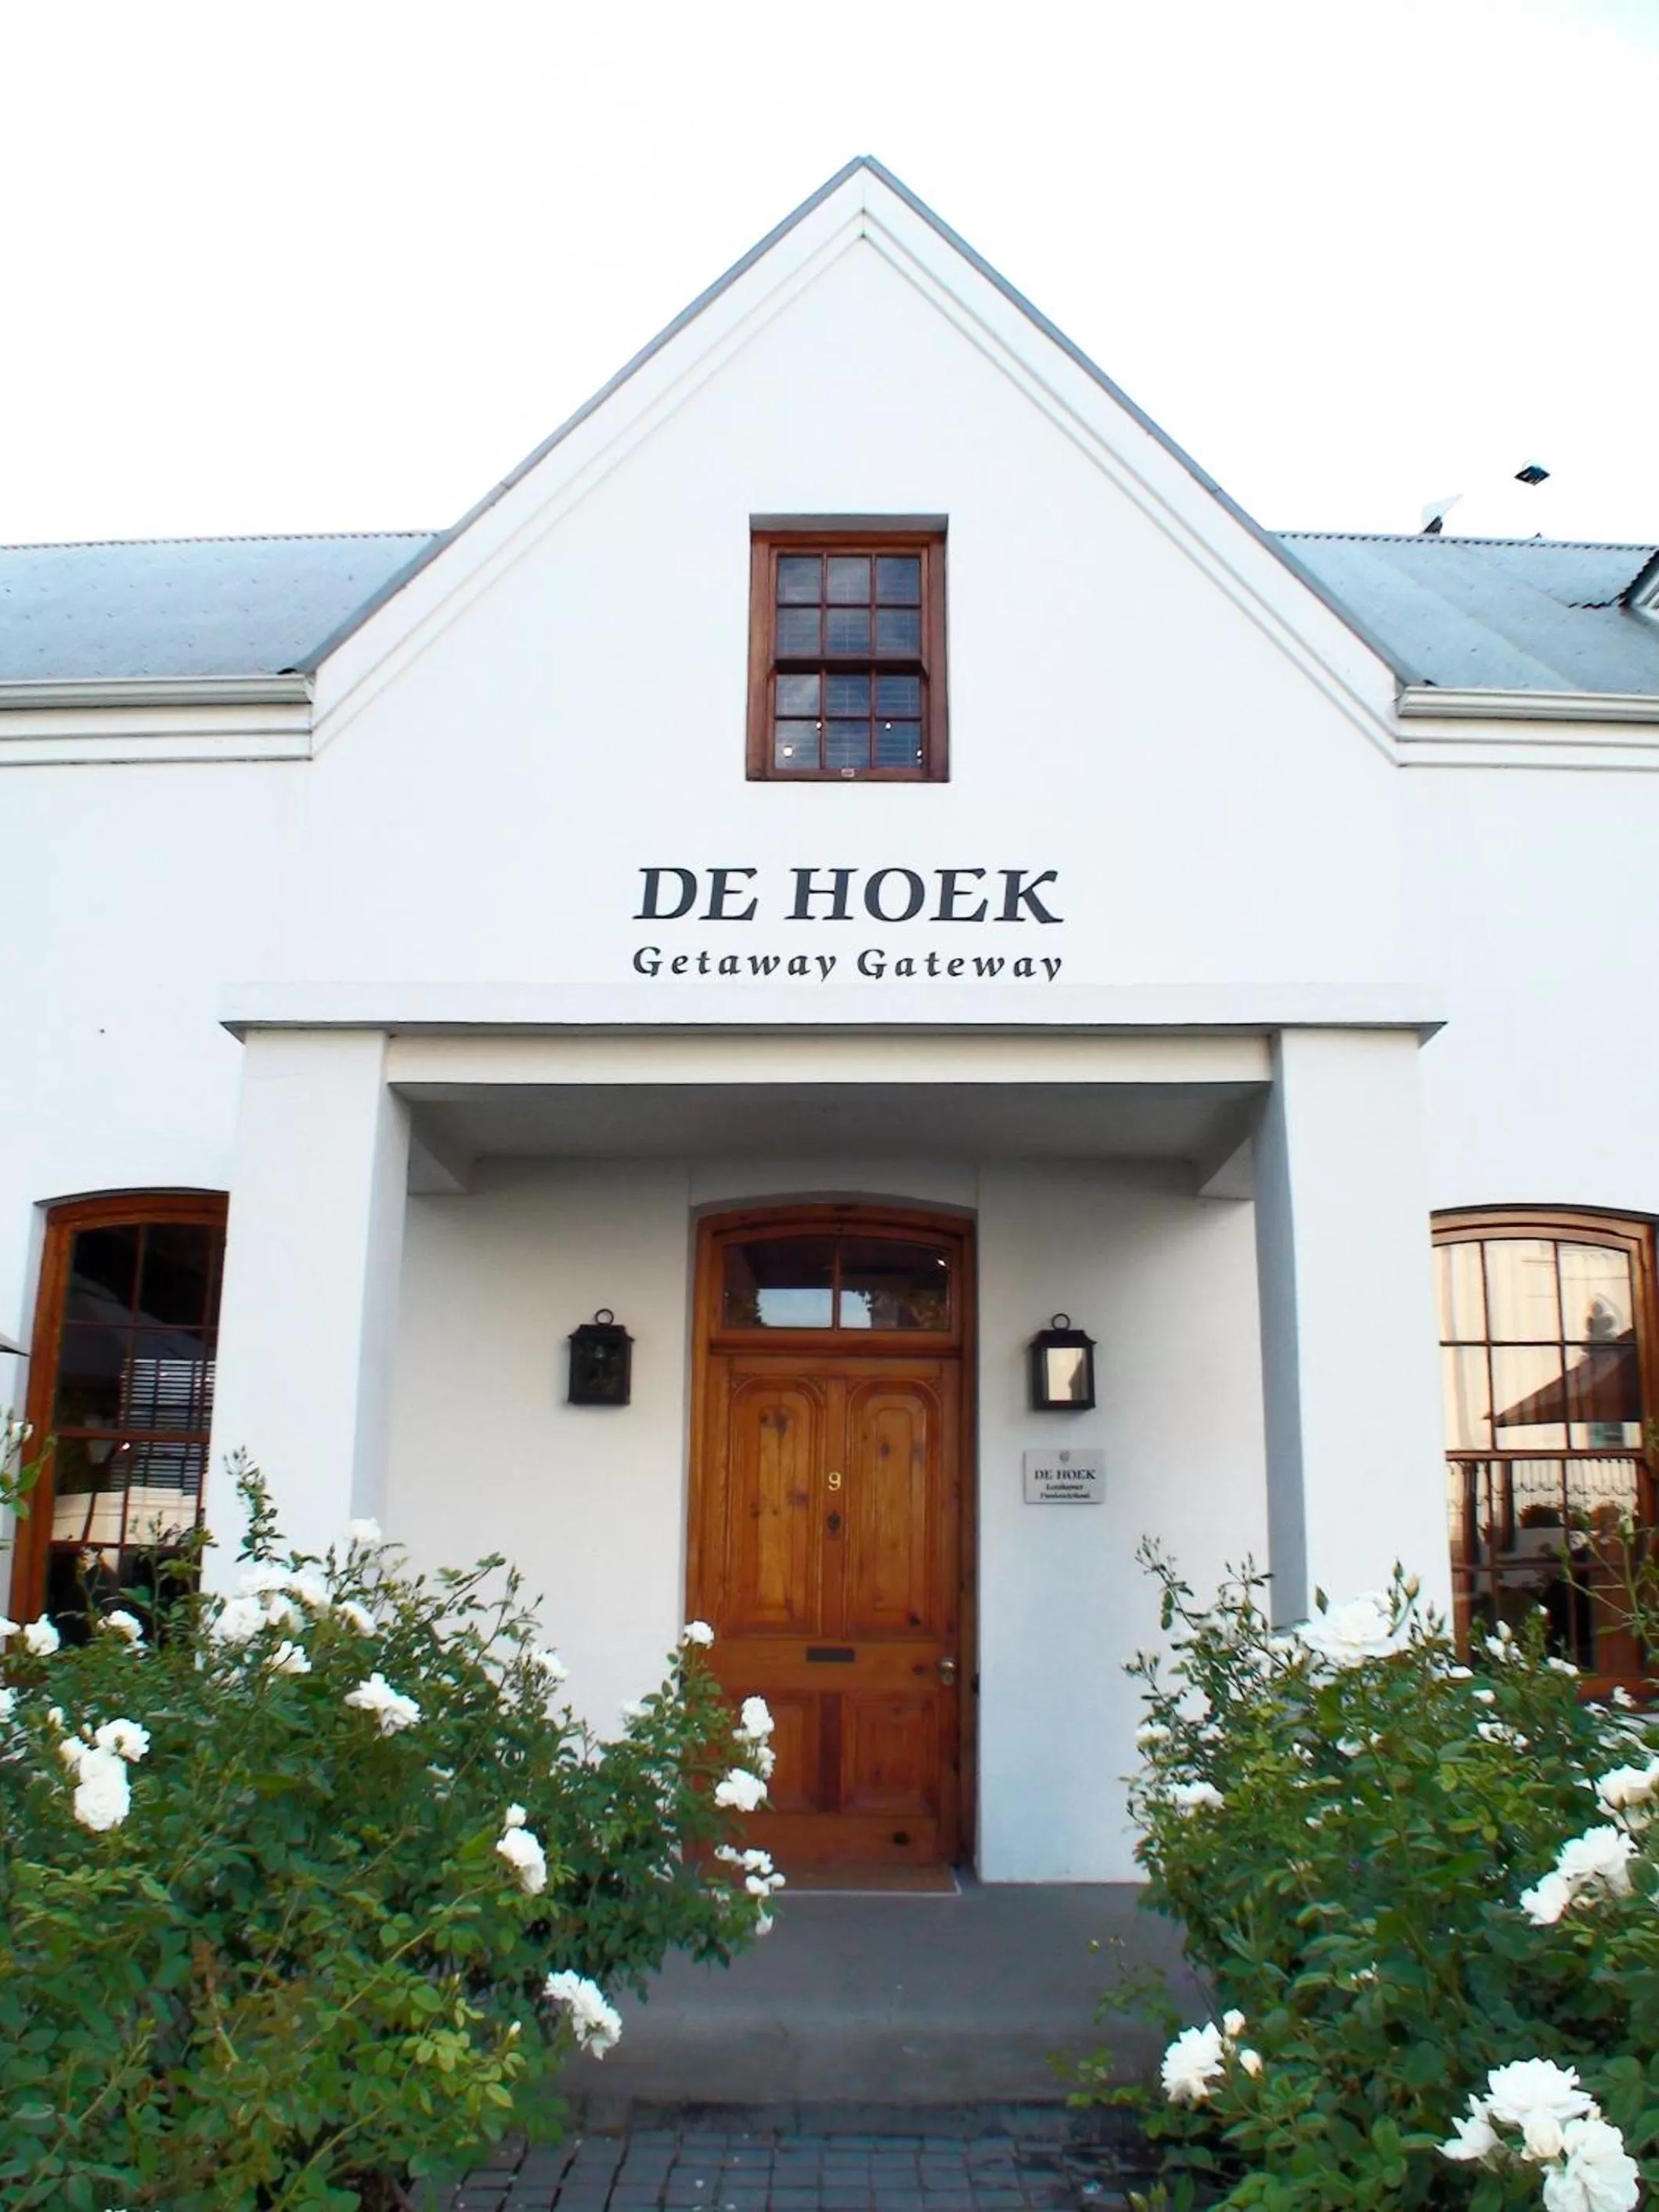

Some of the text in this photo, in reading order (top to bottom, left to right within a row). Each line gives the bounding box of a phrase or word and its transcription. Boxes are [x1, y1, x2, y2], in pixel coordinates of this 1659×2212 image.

[632, 868, 1064, 924] DE HOEK
[633, 946, 1062, 982] Getaway Gateway
[828, 1472, 841, 1491] 9
[1034, 1469, 1096, 1480] DE HOEK
